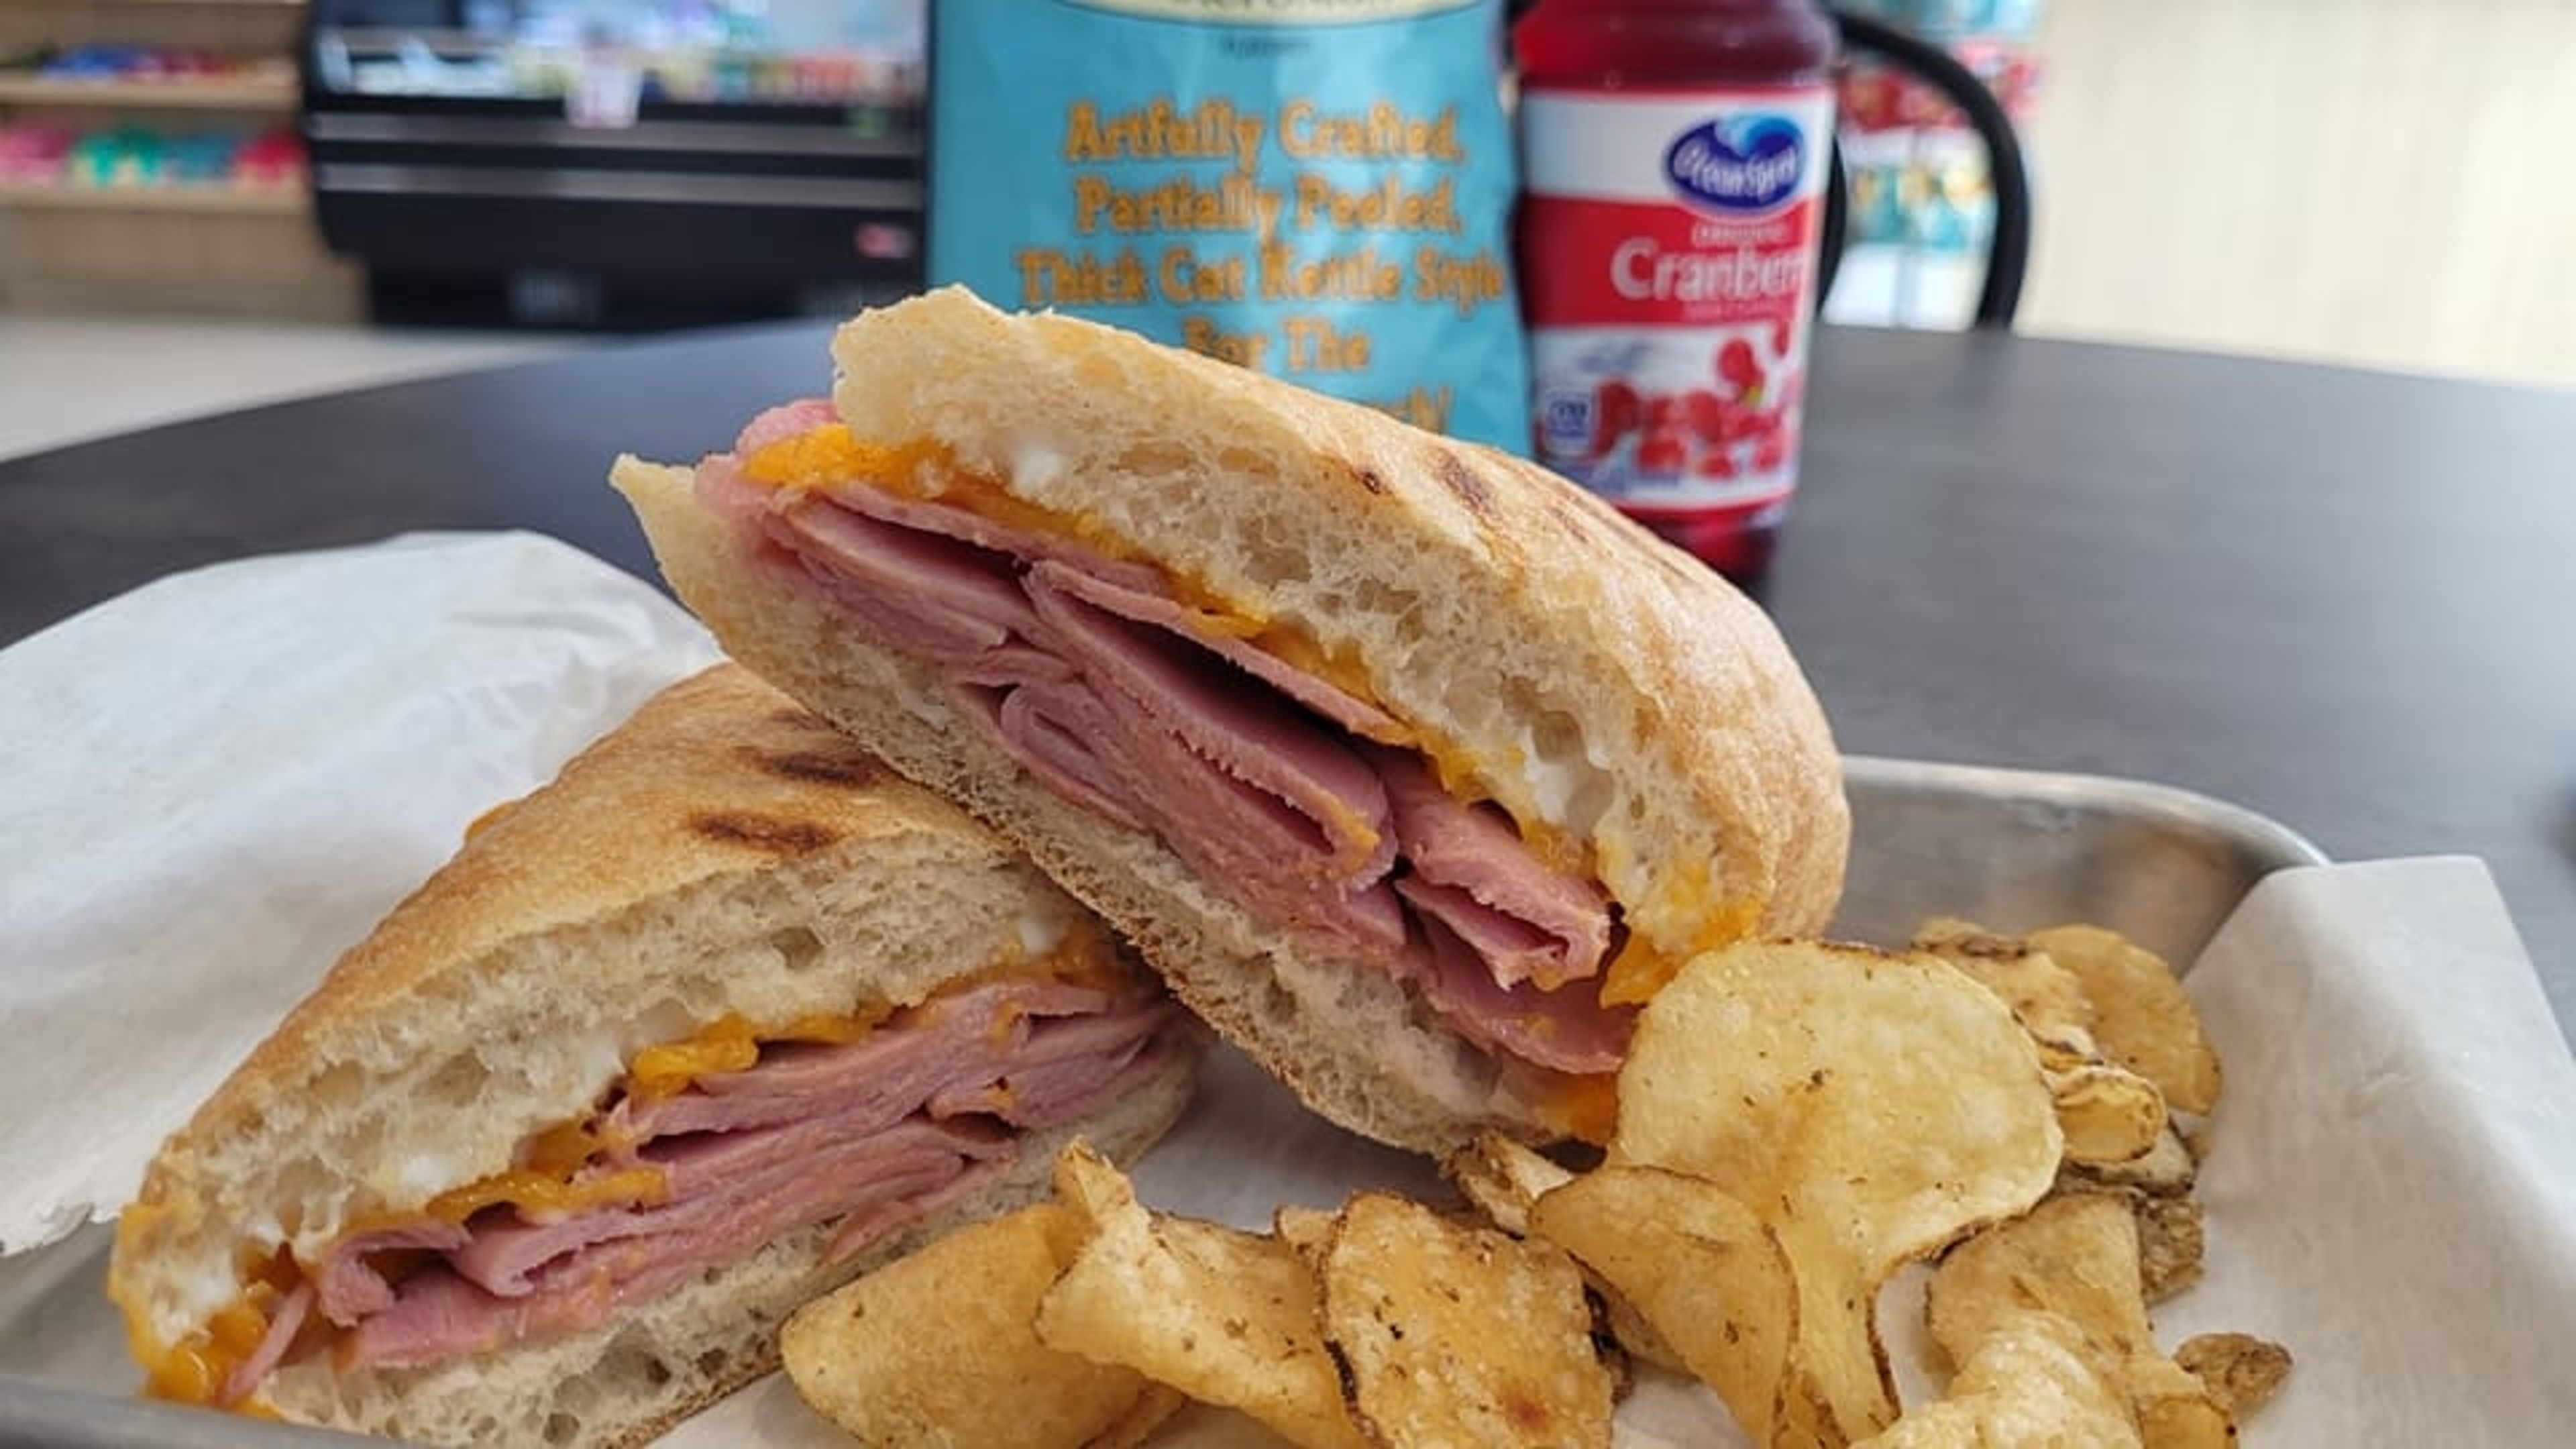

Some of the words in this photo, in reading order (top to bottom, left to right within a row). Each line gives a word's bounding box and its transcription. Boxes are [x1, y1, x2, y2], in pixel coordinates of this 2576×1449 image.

[1067, 99, 1265, 176] Artfully
[1279, 98, 1465, 165] Crafted,
[1075, 173, 1281, 244] Partially
[1296, 173, 1464, 236] Peeled,
[1017, 247, 1144, 305] Thick
[1159, 246, 1246, 303] Cut
[1261, 243, 1401, 302] Kettle
[1414, 247, 1504, 314] Style
[1283, 317, 1371, 370] The
